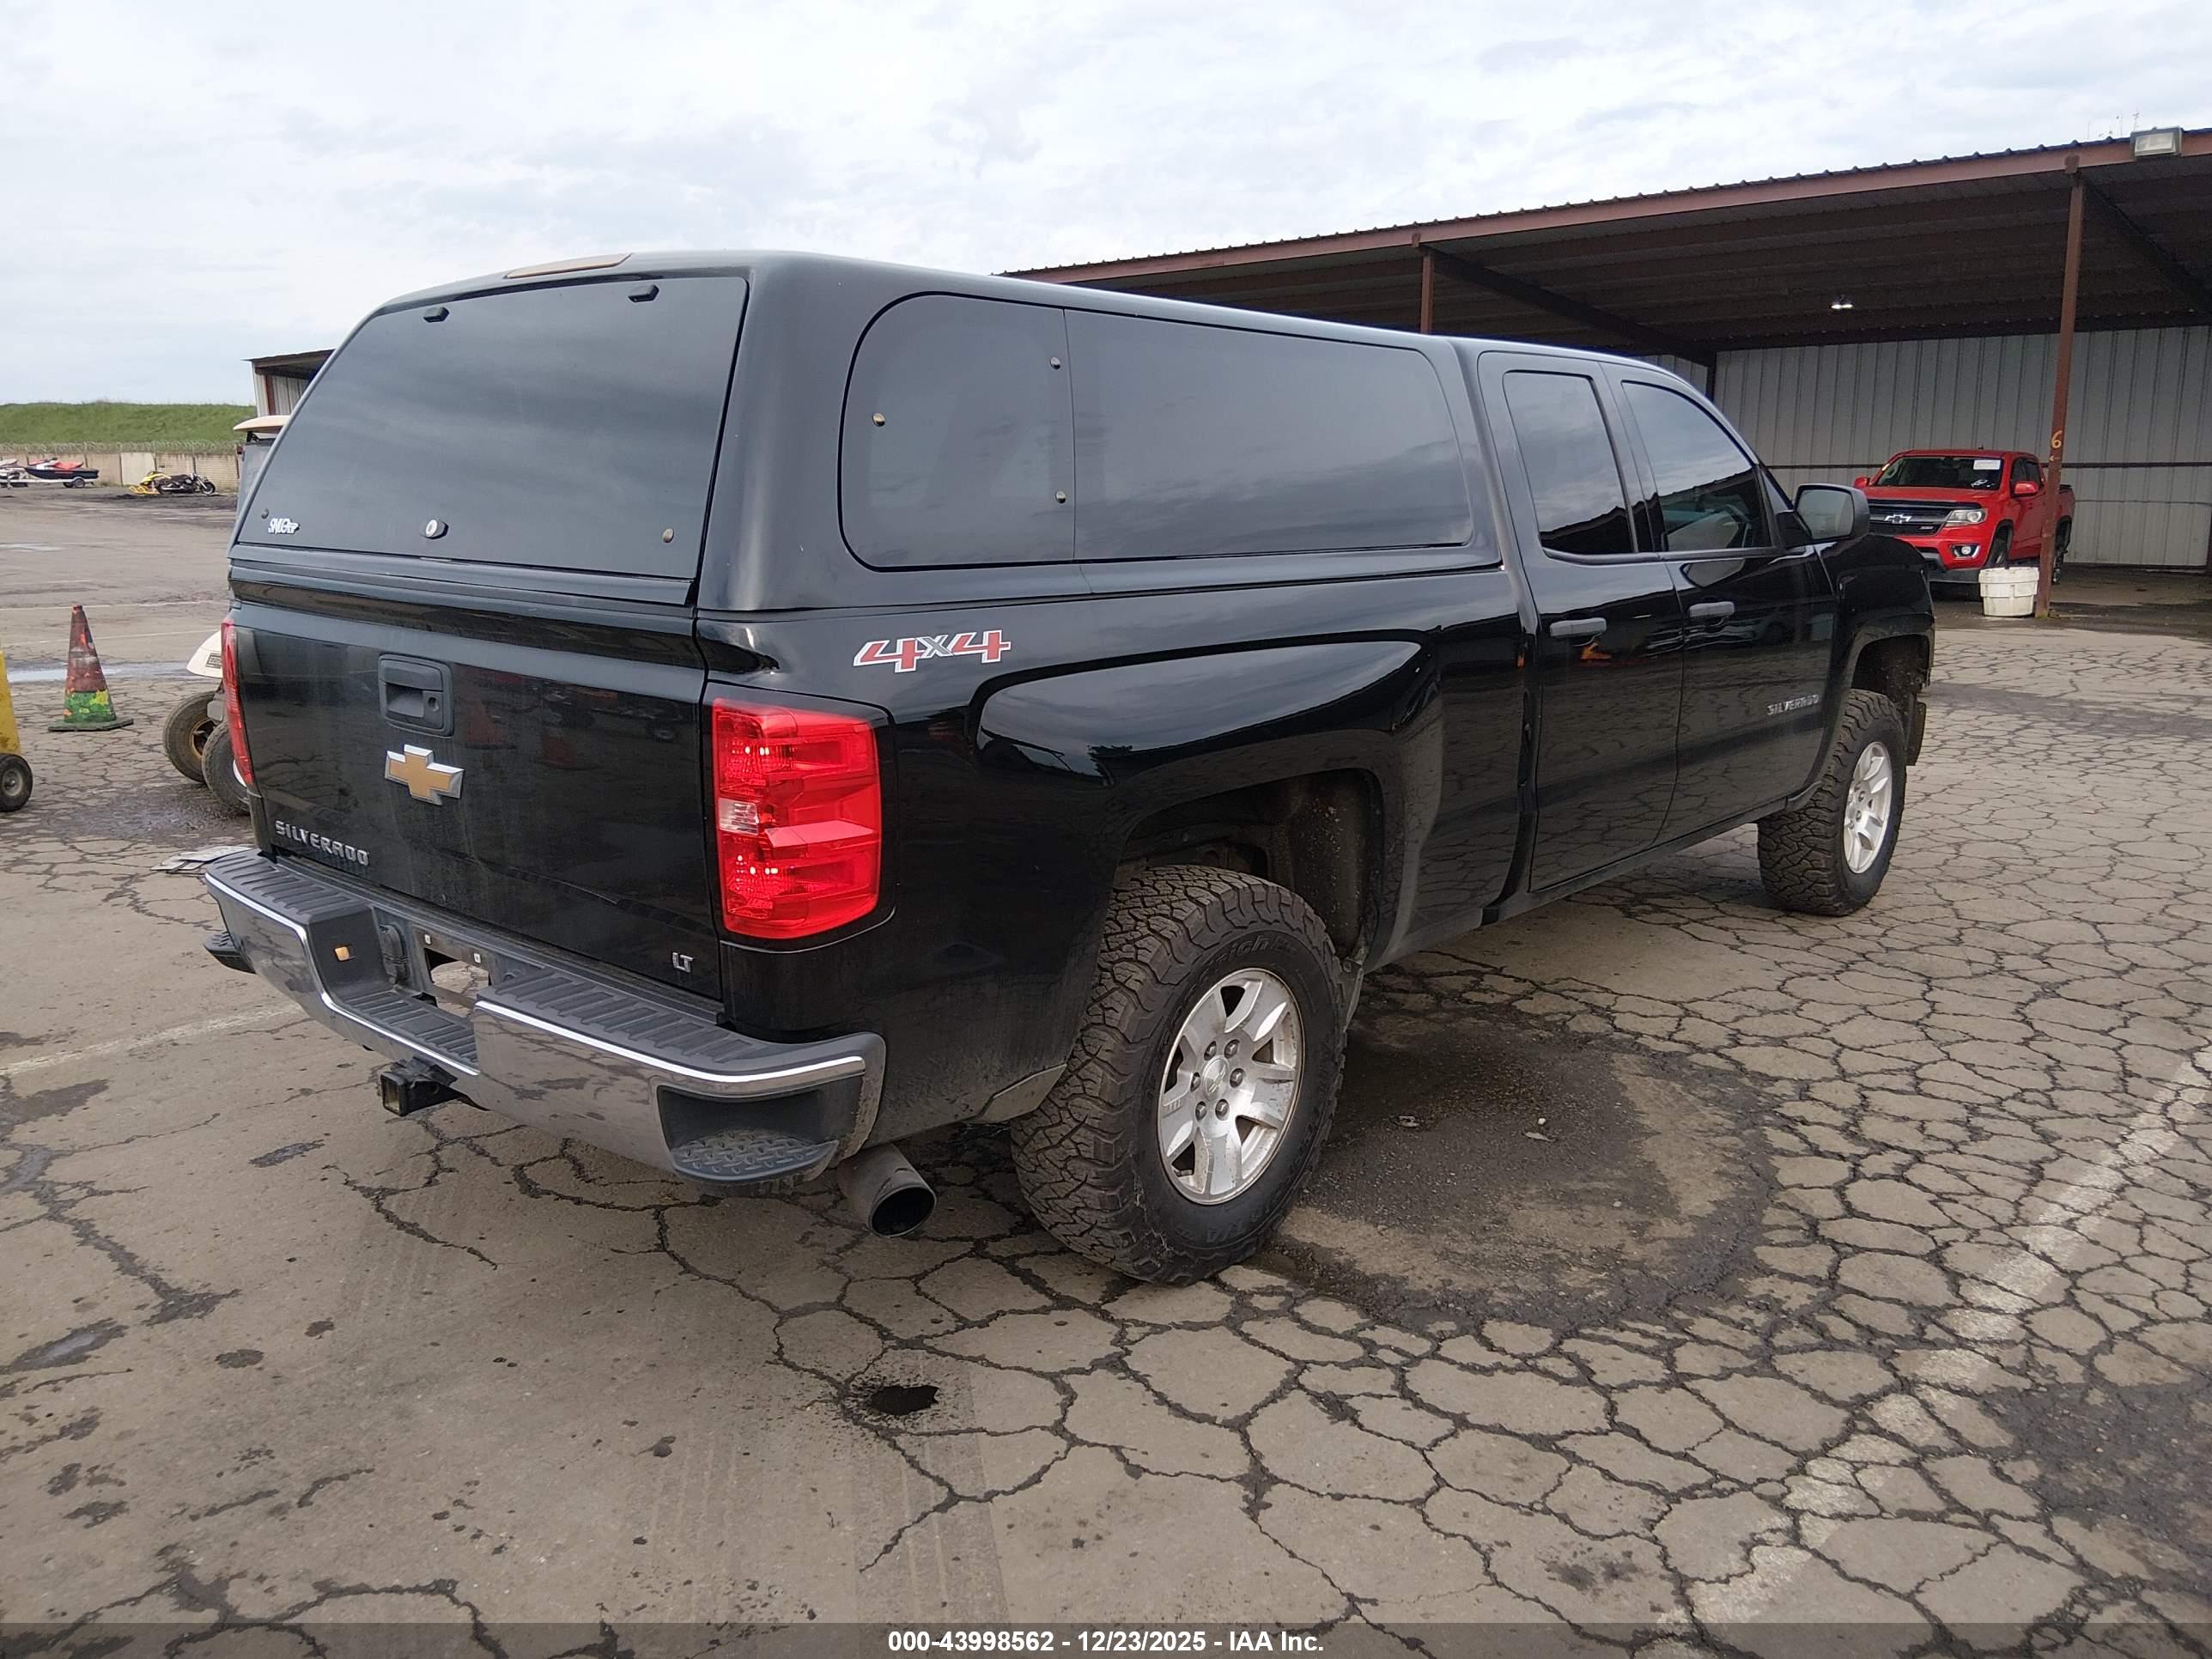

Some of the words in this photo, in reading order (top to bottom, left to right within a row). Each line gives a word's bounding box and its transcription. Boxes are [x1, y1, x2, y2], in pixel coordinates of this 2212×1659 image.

[2051, 429, 2063, 449] 6
[1767, 694, 1820, 715] SILVERADO
[275, 820, 370, 867] SILVERADO
[672, 951, 696, 974] LT
